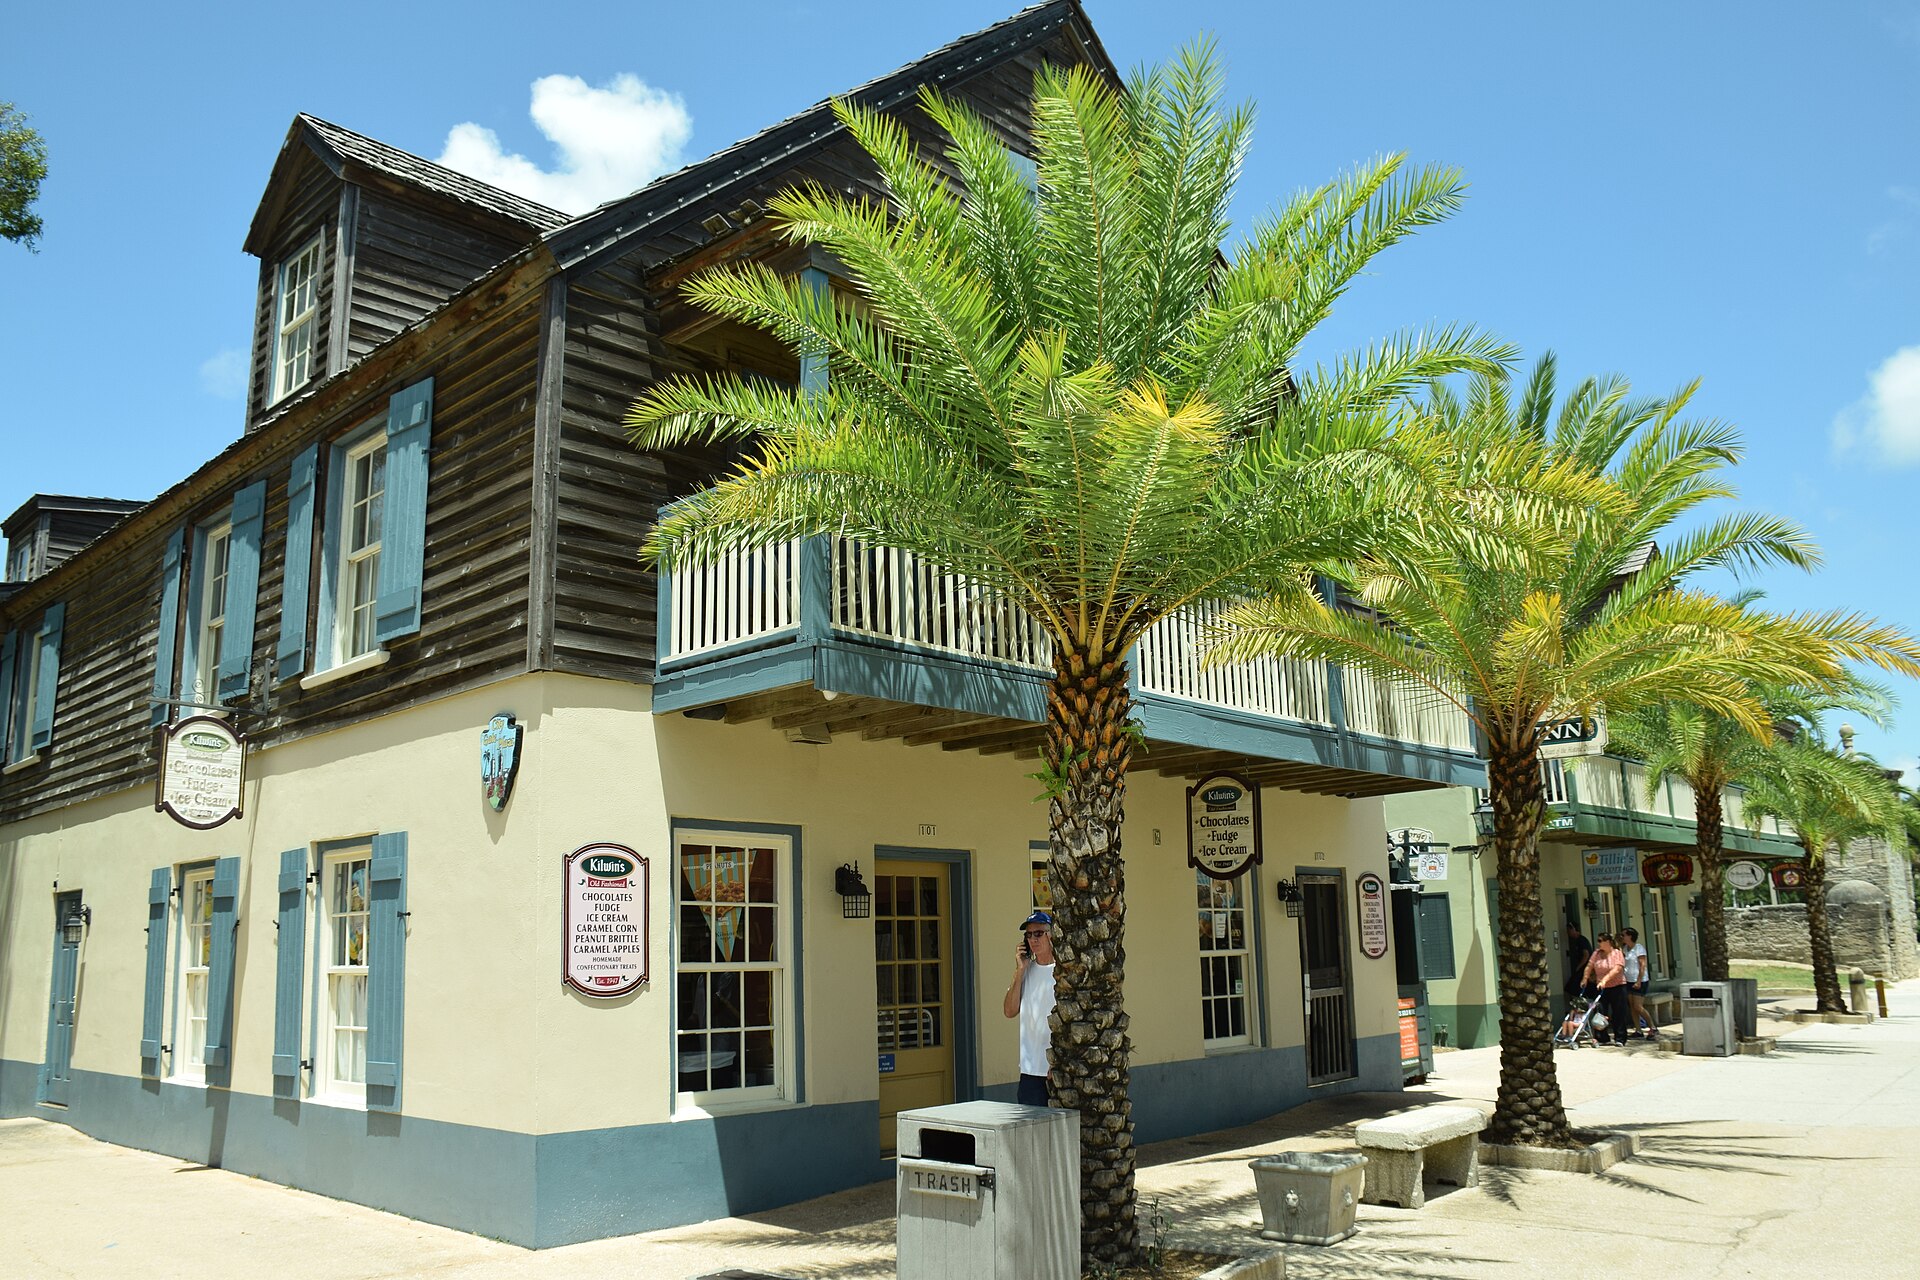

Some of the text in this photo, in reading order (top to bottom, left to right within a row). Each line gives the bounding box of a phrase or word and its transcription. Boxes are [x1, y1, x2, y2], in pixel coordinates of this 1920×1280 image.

[189, 734, 222, 749] Kilwin's
[173, 760, 234, 779] Chocolates
[187, 777, 219, 794] Fudge
[174, 791, 227, 808] Ice Cream
[1208, 789, 1236, 801] Kilwin's
[1200, 814, 1250, 828] Chocolates
[921, 825, 936, 836] 101
[1211, 830, 1239, 843] Fudge
[1203, 844, 1248, 856] Ice Cream
[1599, 852, 1634, 866] Tillie's
[590, 858, 626, 873] Kilwin's
[601, 880, 625, 888] Fashioned
[582, 892, 633, 902] CHOCOLATES
[594, 903, 620, 912] FUDGE
[586, 913, 628, 922] ICE CREAM
[576, 924, 638, 933] CARAMEL CORN
[575, 934, 639, 943] PEANUT BRITTLE
[573, 945, 640, 954] CARAMEL APPLES
[914, 1171, 971, 1194] TRASH
